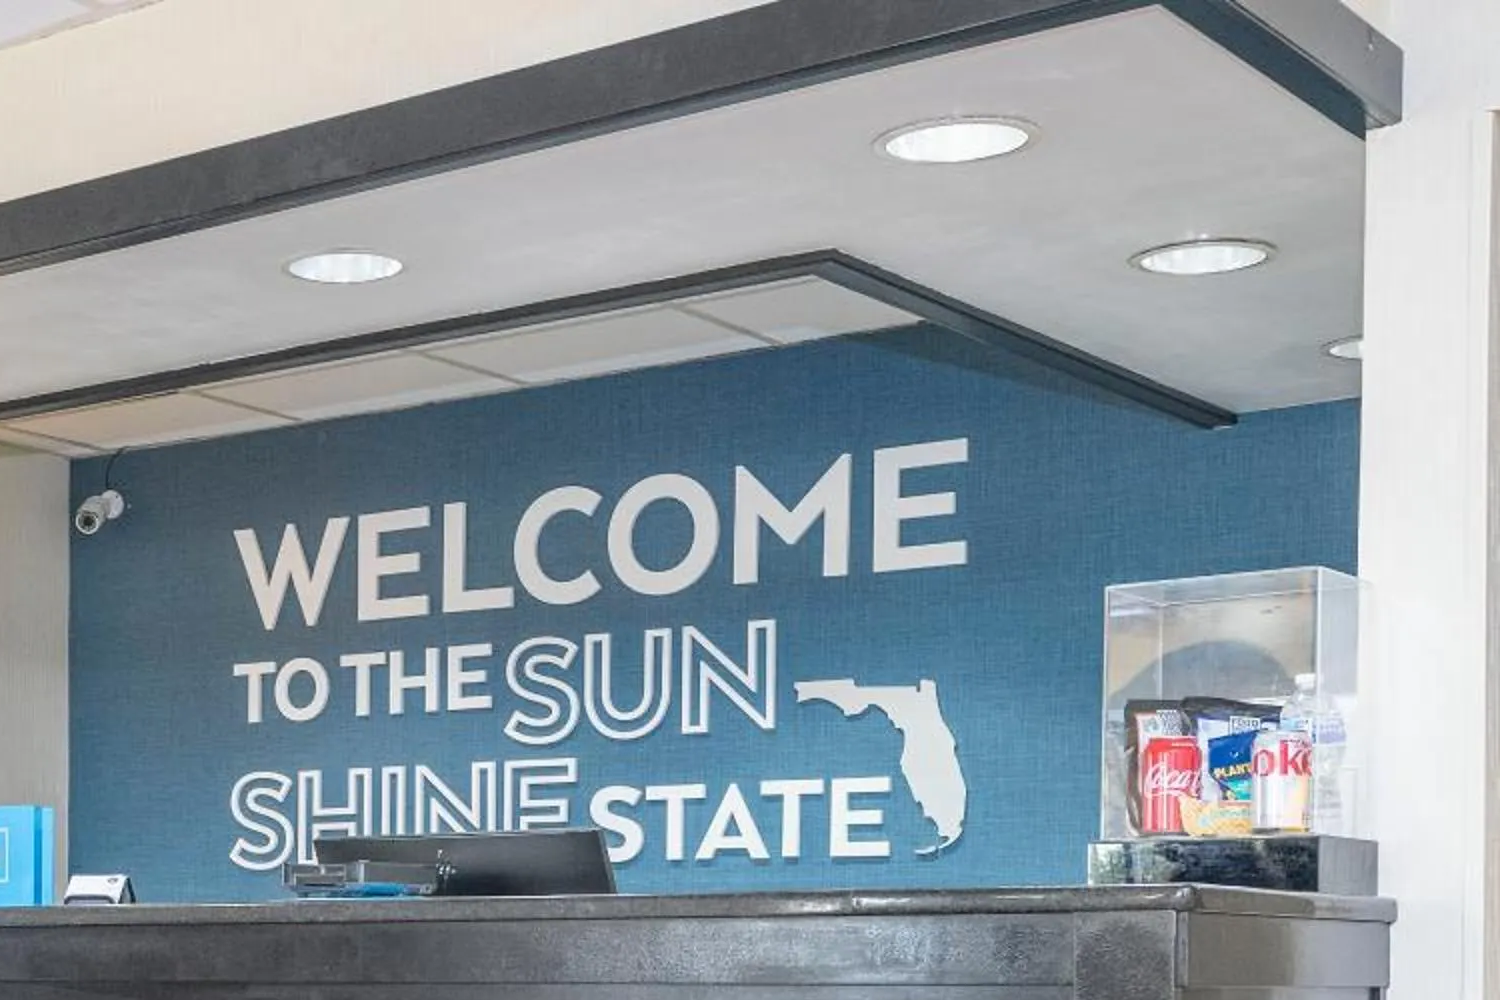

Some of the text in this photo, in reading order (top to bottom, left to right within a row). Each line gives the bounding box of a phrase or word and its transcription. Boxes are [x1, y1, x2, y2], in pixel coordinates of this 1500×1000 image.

[233, 437, 969, 631] WELCOME
[233, 618, 777, 745] TO THE SUN
[589, 776, 892, 863] STATE
